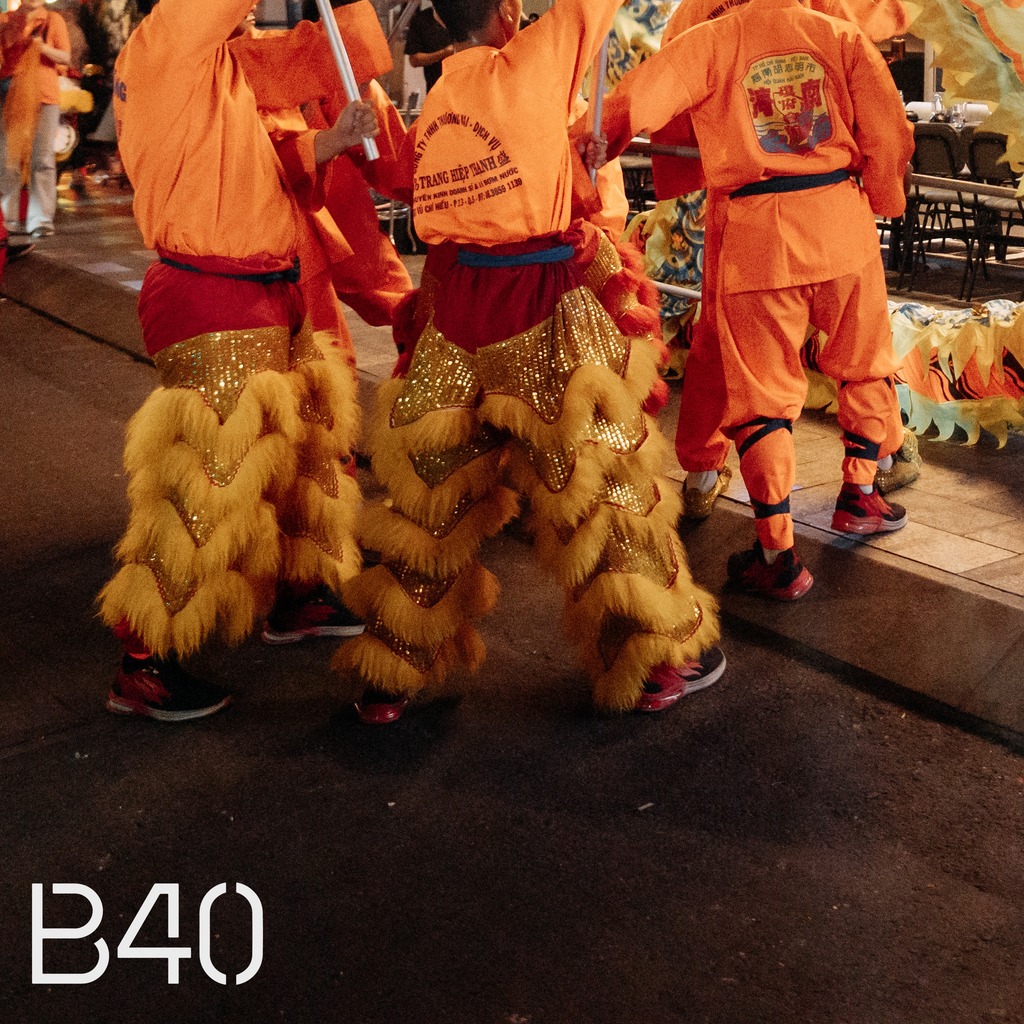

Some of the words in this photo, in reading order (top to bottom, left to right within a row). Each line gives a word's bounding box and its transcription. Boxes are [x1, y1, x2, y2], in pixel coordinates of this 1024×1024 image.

[417, 139, 427, 151] TY
[424, 121, 440, 141] TNHH
[472, 121, 490, 141] DỊCH
[487, 136, 502, 152] VỤ
[419, 171, 450, 190] TRANG
[450, 164, 470, 183] HIỆP
[433, 190, 448, 200] KINH
[449, 187, 468, 196] DOANH
